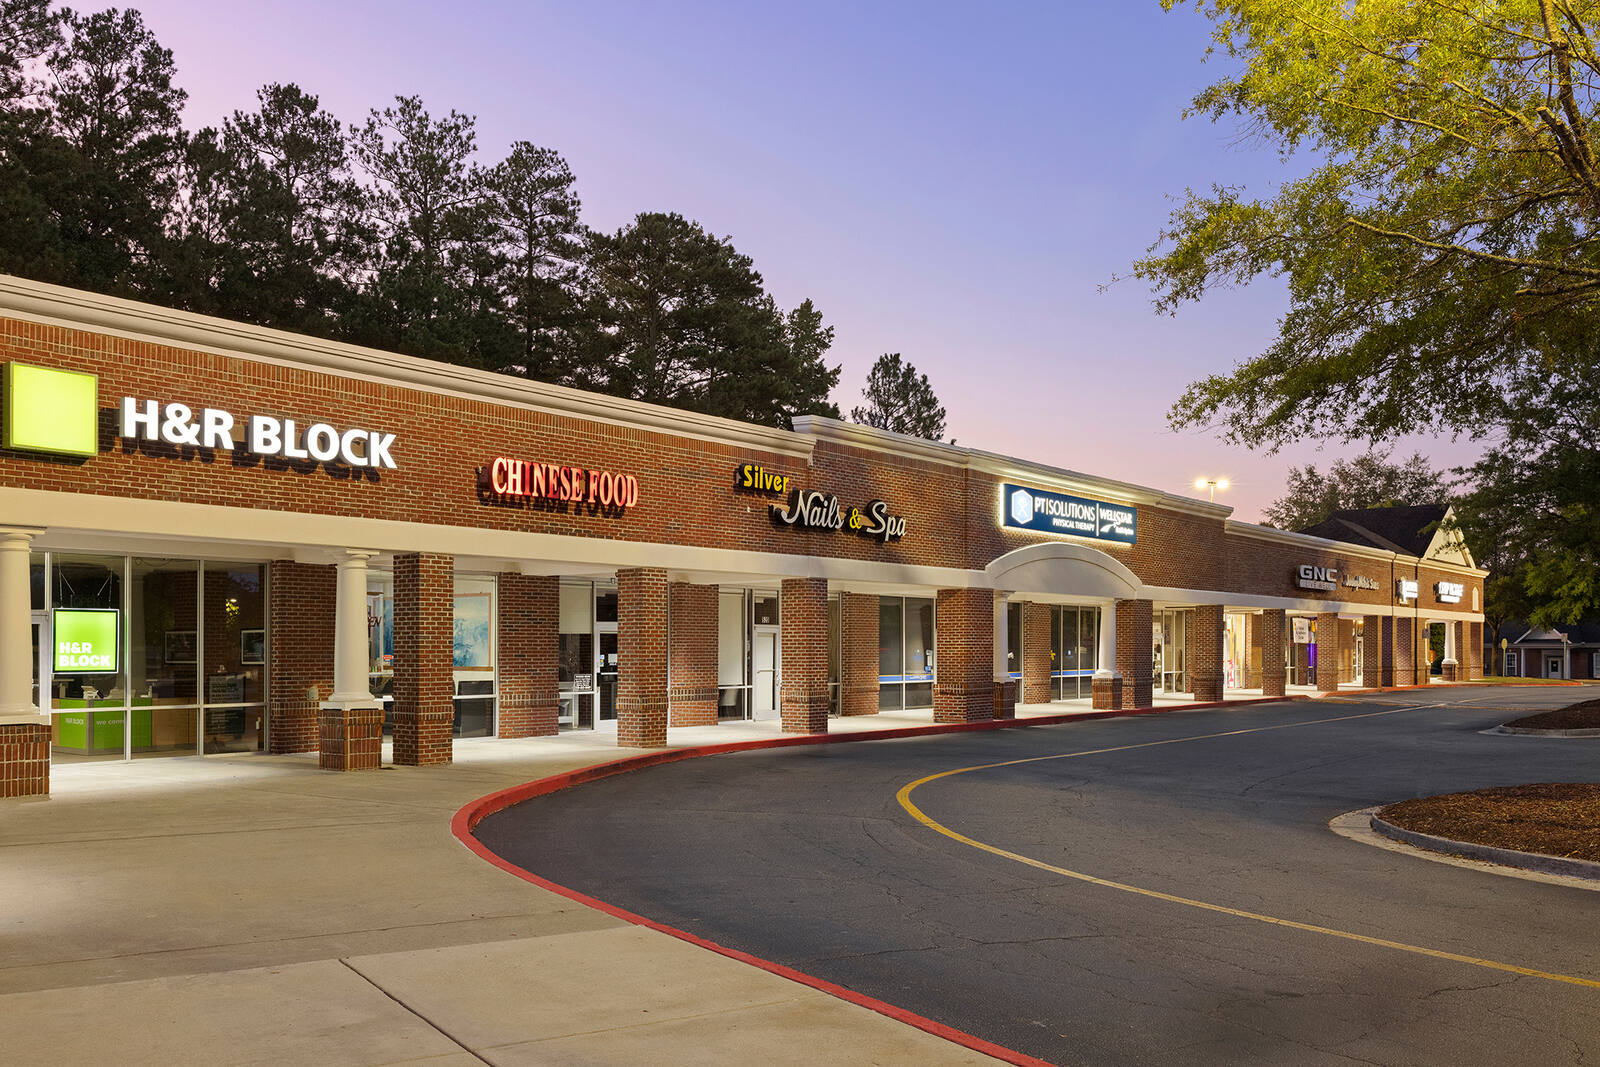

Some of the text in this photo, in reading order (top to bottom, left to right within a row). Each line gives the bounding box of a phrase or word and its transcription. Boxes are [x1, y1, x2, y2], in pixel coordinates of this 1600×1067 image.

[120, 396, 398, 469] H&R BLOCK
[492, 456, 639, 508] CHINESE FOOD
[743, 464, 790, 493] Silver
[780, 489, 907, 542] Nails & Spa
[1035, 497, 1096, 521] PT SOLUTIONS
[1053, 518, 1095, 532] PHYSICAL THERAPY
[1299, 564, 1338, 583] GNC
[59, 641, 92, 654] H&R
[58, 654, 111, 667] BLOCK
